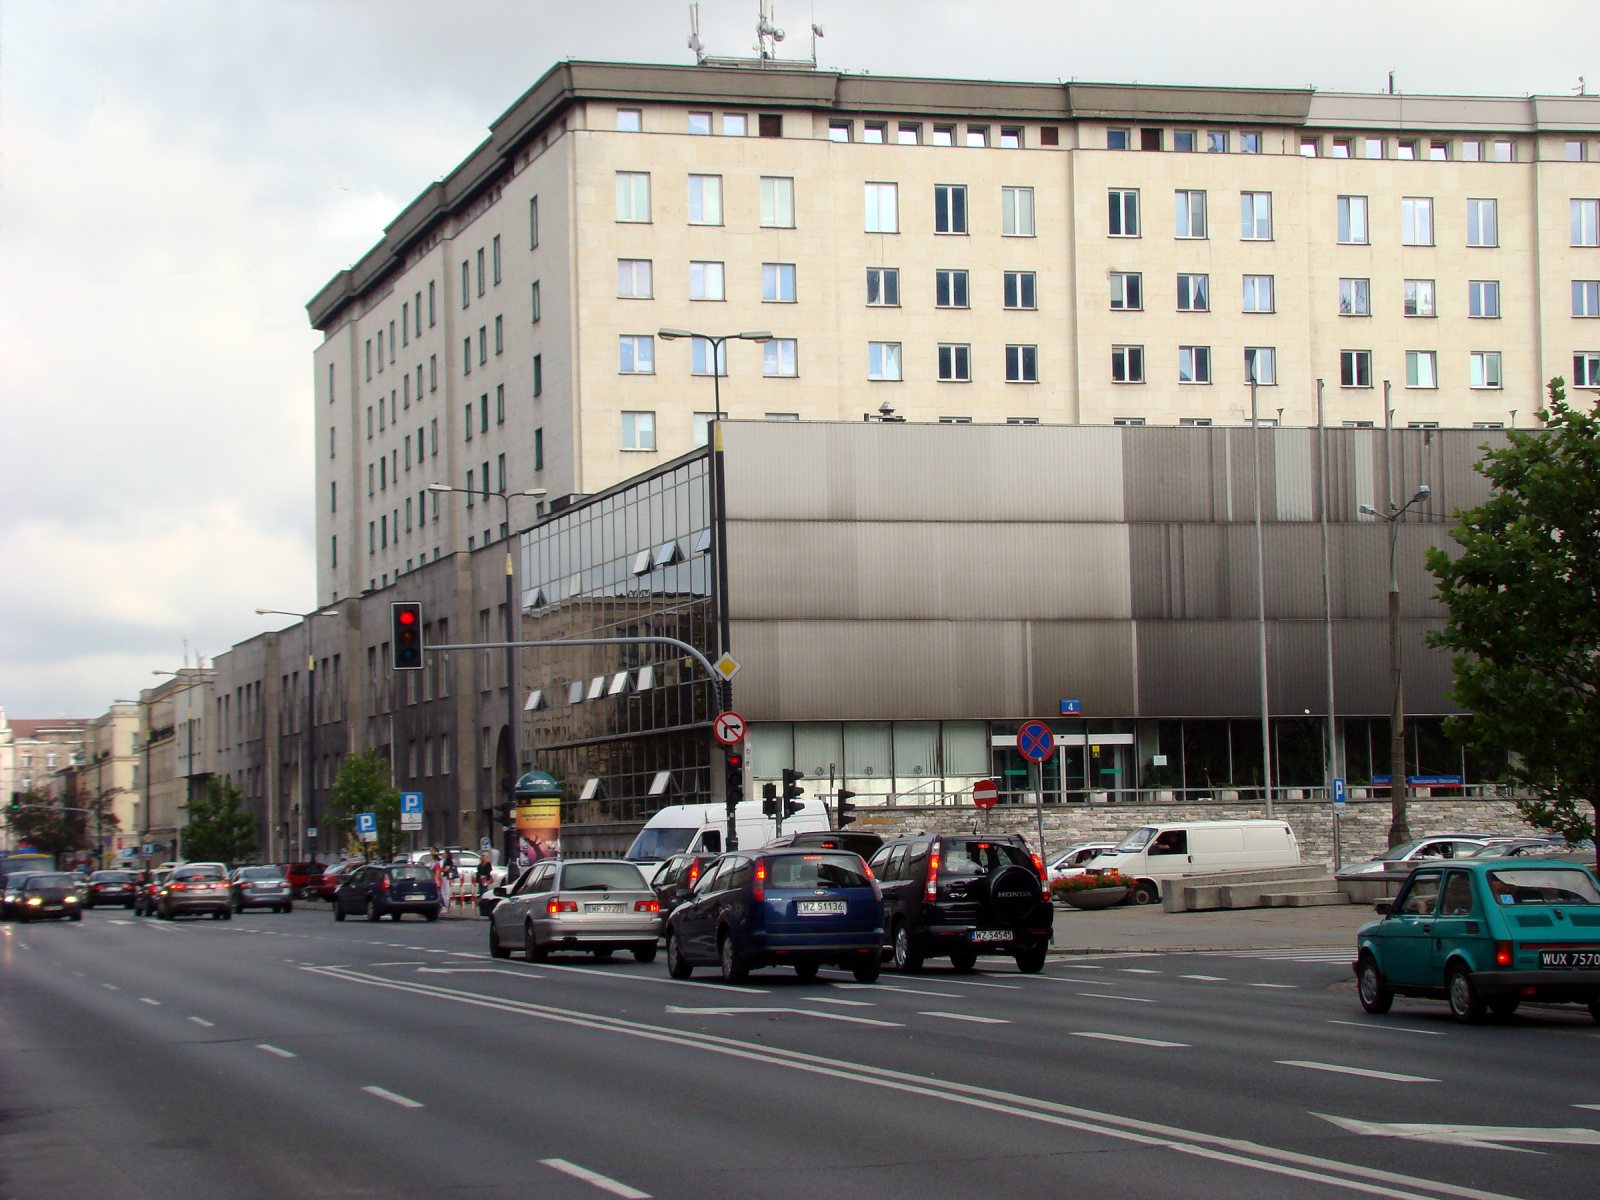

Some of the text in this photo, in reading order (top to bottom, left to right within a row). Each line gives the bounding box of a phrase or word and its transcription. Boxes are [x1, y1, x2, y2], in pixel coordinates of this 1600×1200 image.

[1068, 702, 1074, 712] 4
[1335, 781, 1343, 800] P
[405, 795, 418, 811] P
[360, 815, 373, 830] P
[803, 902, 843, 911] WZ 51136
[976, 931, 986, 940] WZ
[1542, 953, 1600, 966] WUX 7570
